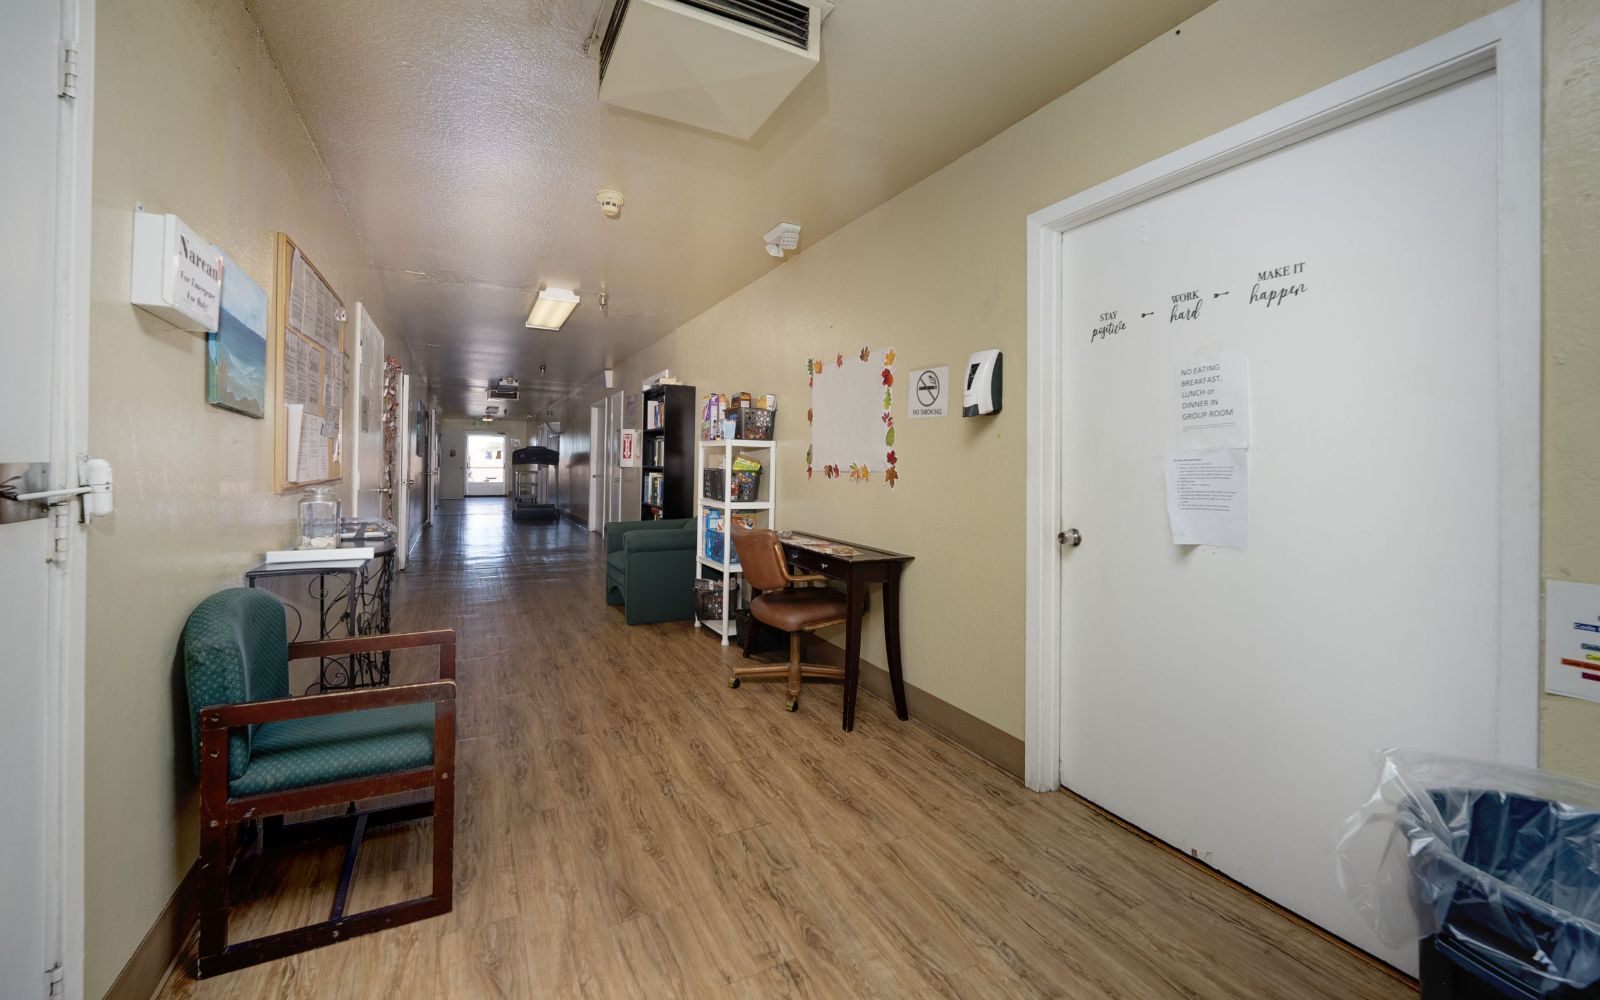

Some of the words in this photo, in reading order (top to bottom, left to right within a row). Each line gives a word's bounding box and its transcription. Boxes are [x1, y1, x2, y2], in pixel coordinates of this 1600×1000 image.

[180, 234, 218, 282] Narcan
[1258, 265, 1291, 281] MAKE
[1293, 262, 1306, 274] IT
[1171, 289, 1200, 304] WORK
[1249, 283, 1308, 308] happen
[1099, 310, 1118, 322] STAY
[1169, 298, 1203, 323] hard
[1091, 321, 1127, 343] positive
[1181, 368, 1192, 376] NO
[1193, 364, 1220, 374] EATING
[1181, 389, 1206, 399] LUNCH
[1182, 400, 1209, 409] DINNER
[1182, 411, 1208, 421] GROUP
[1209, 408, 1234, 418] ROOM
